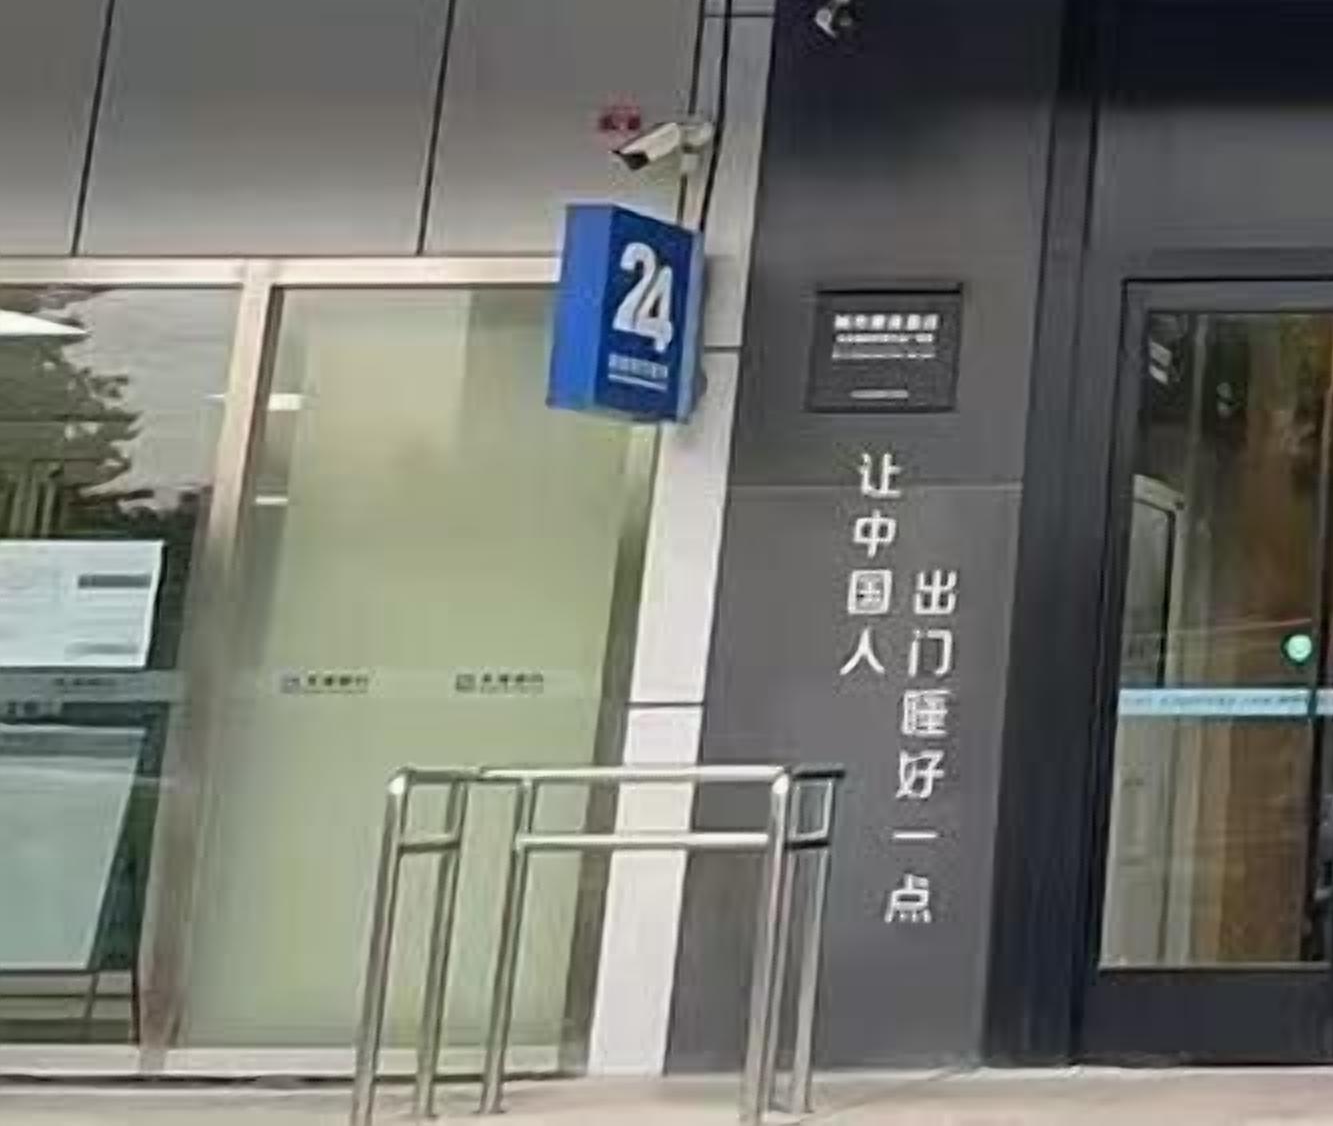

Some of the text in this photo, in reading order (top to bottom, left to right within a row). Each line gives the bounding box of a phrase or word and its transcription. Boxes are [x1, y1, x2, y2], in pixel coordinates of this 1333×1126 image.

[612, 241, 674, 354] 24
[840, 452, 902, 676] 让中国人
